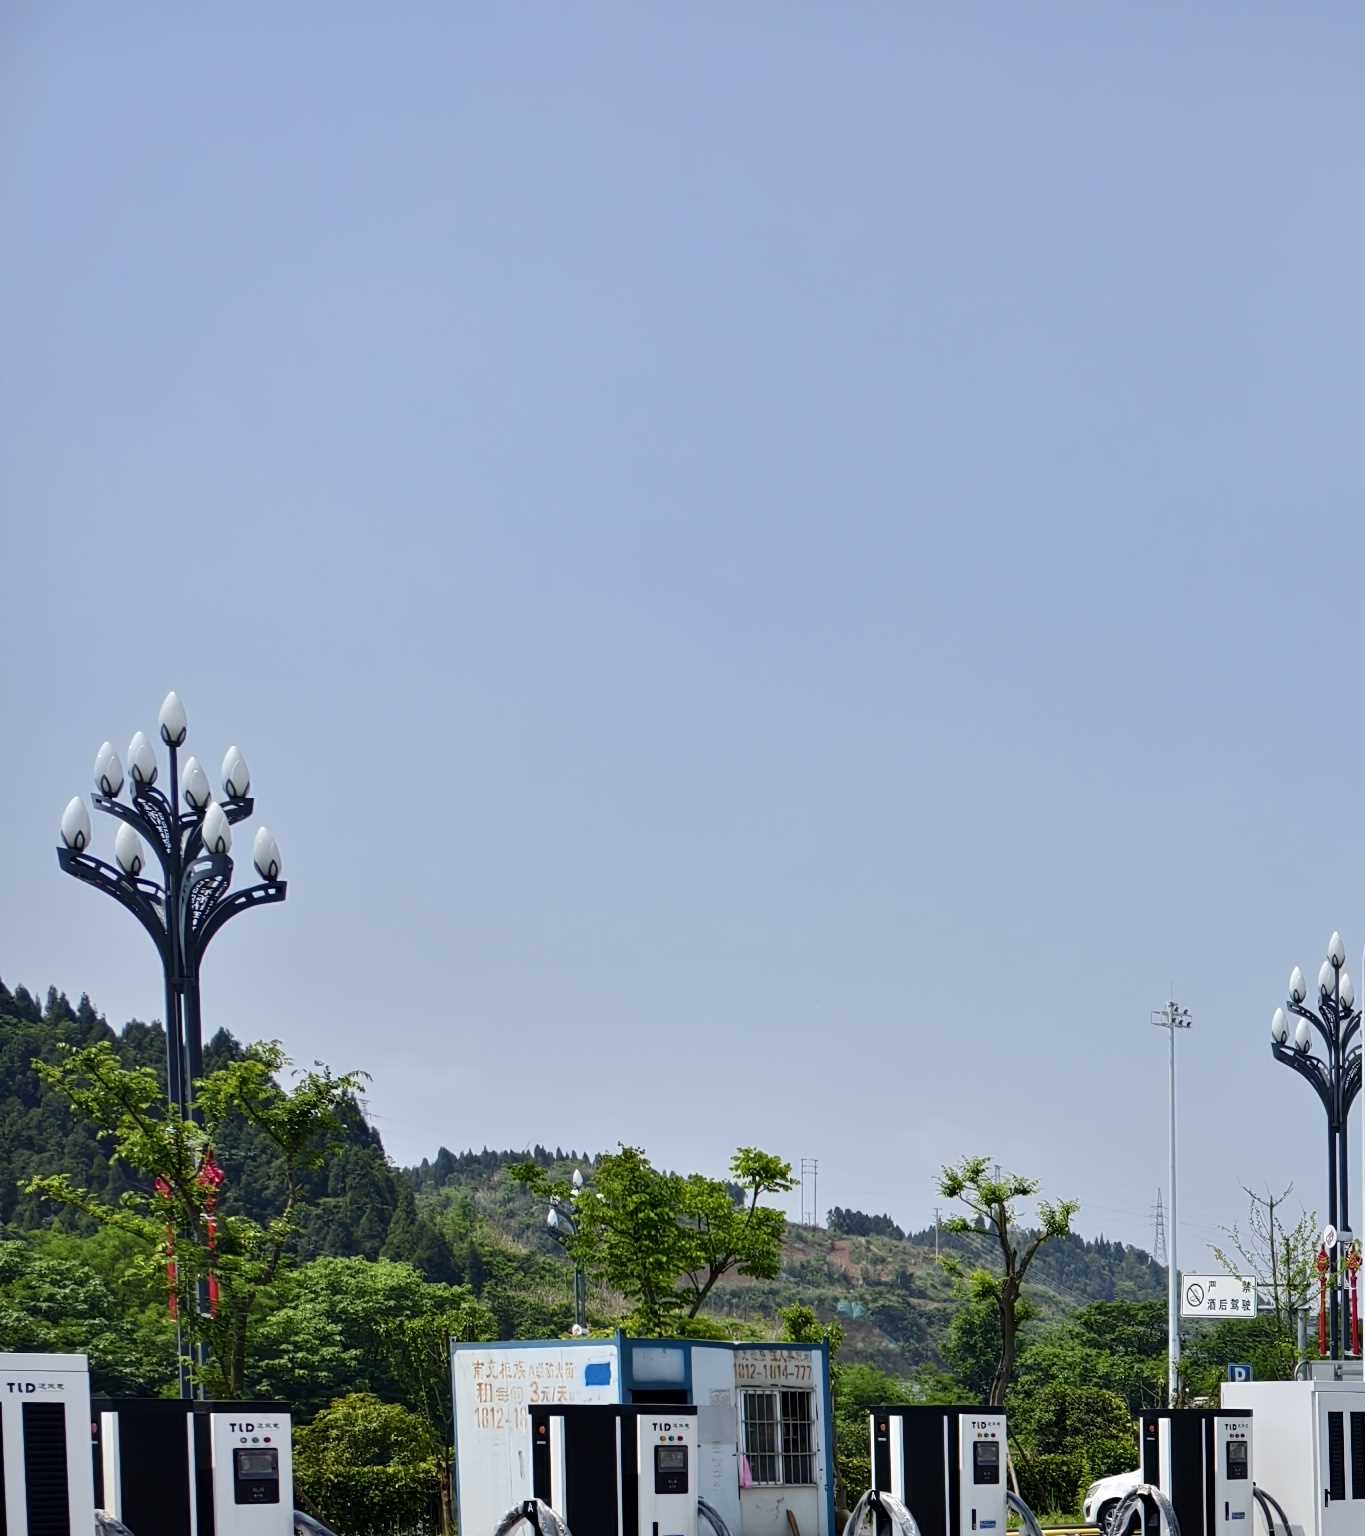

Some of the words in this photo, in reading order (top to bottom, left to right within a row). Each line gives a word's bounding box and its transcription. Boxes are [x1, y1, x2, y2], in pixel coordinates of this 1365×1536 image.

[1207, 1299, 1251, 1311] 酒后驾驶
[1234, 1367, 1246, 1382] P
[527, 1502, 534, 1512] A
